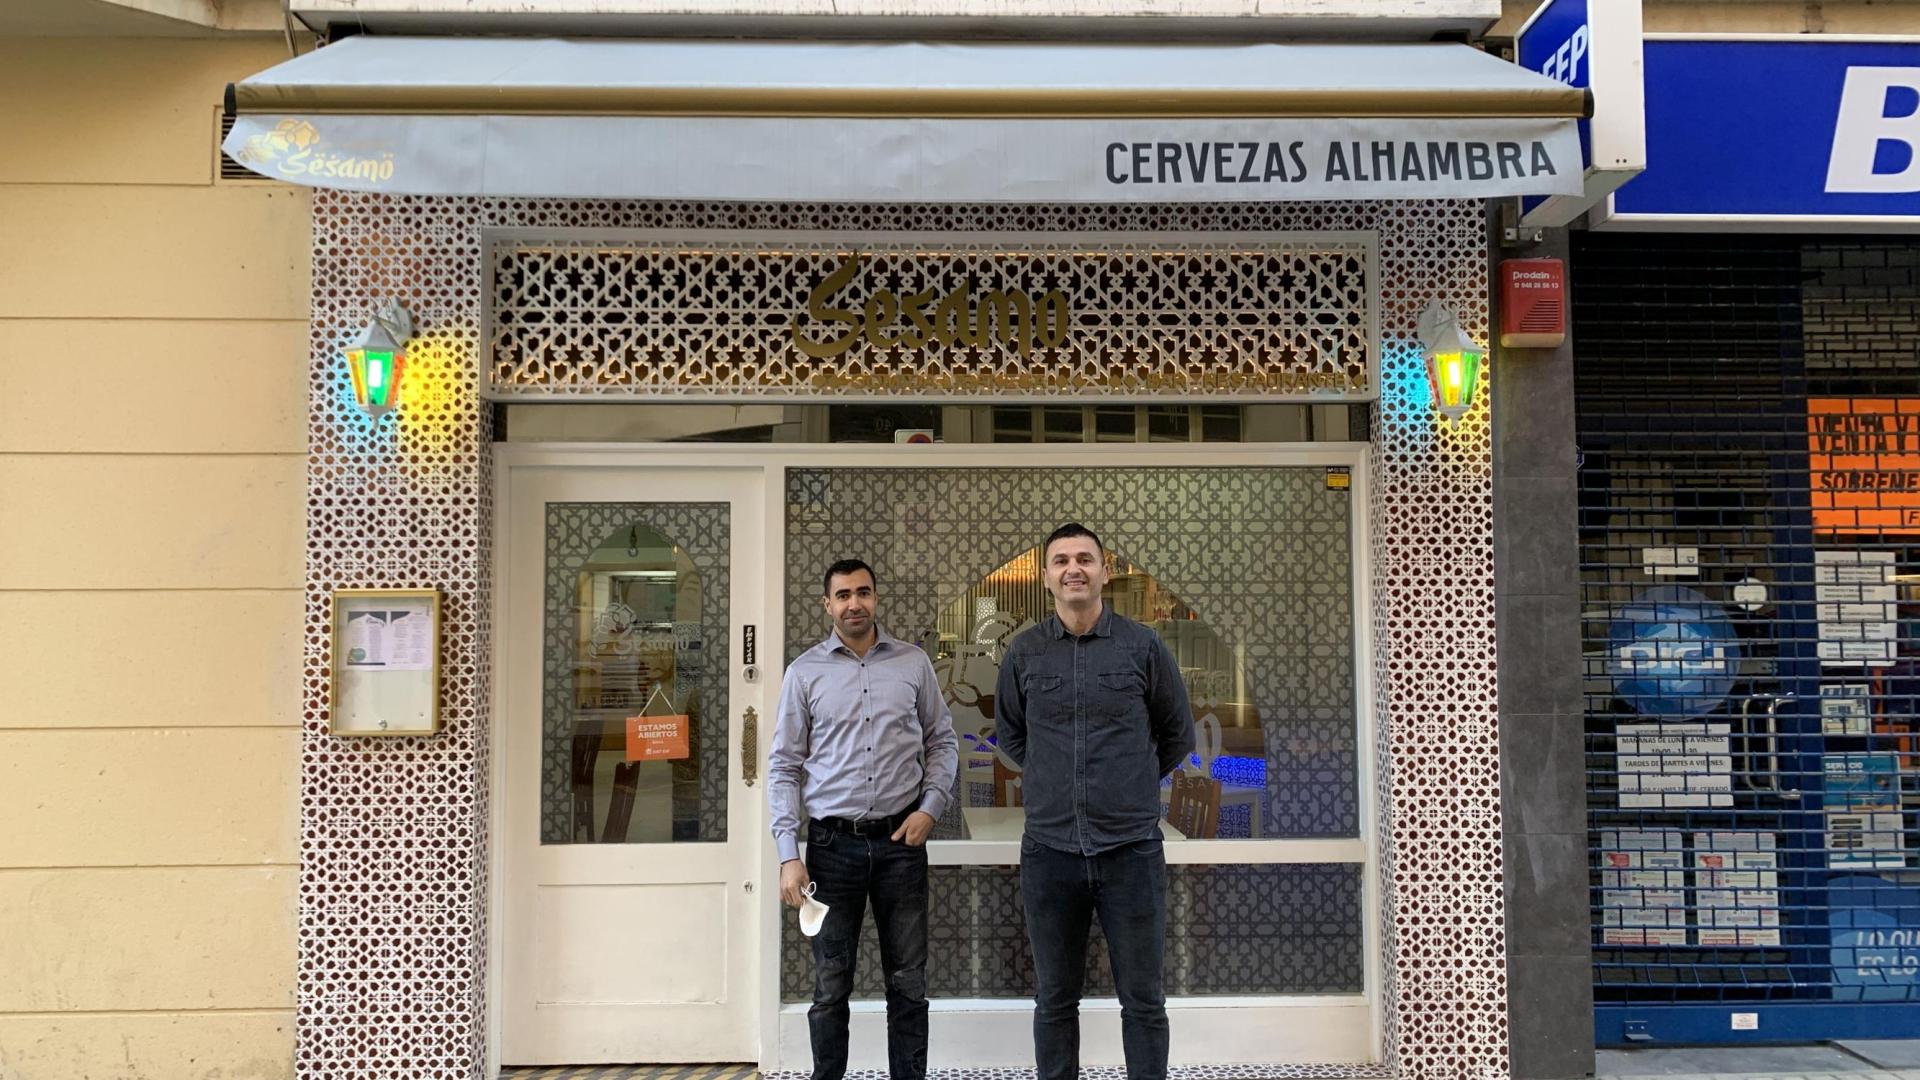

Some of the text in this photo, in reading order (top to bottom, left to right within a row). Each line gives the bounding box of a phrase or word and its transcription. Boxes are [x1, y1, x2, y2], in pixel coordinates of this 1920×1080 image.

[1539, 24, 1588, 84] EEP
[1825, 66, 1920, 194] B
[1106, 141, 1557, 185] CERVEZAS ALHAMBRA
[793, 249, 1068, 360] Sesamo
[1814, 414, 1888, 456] VENTA
[1896, 414, 1909, 456] Y
[1621, 647, 1725, 669] DIGI
[638, 723, 678, 731] ESTAMOS
[638, 730, 678, 739] ABIERTOS
[1891, 955, 1918, 976] LO
